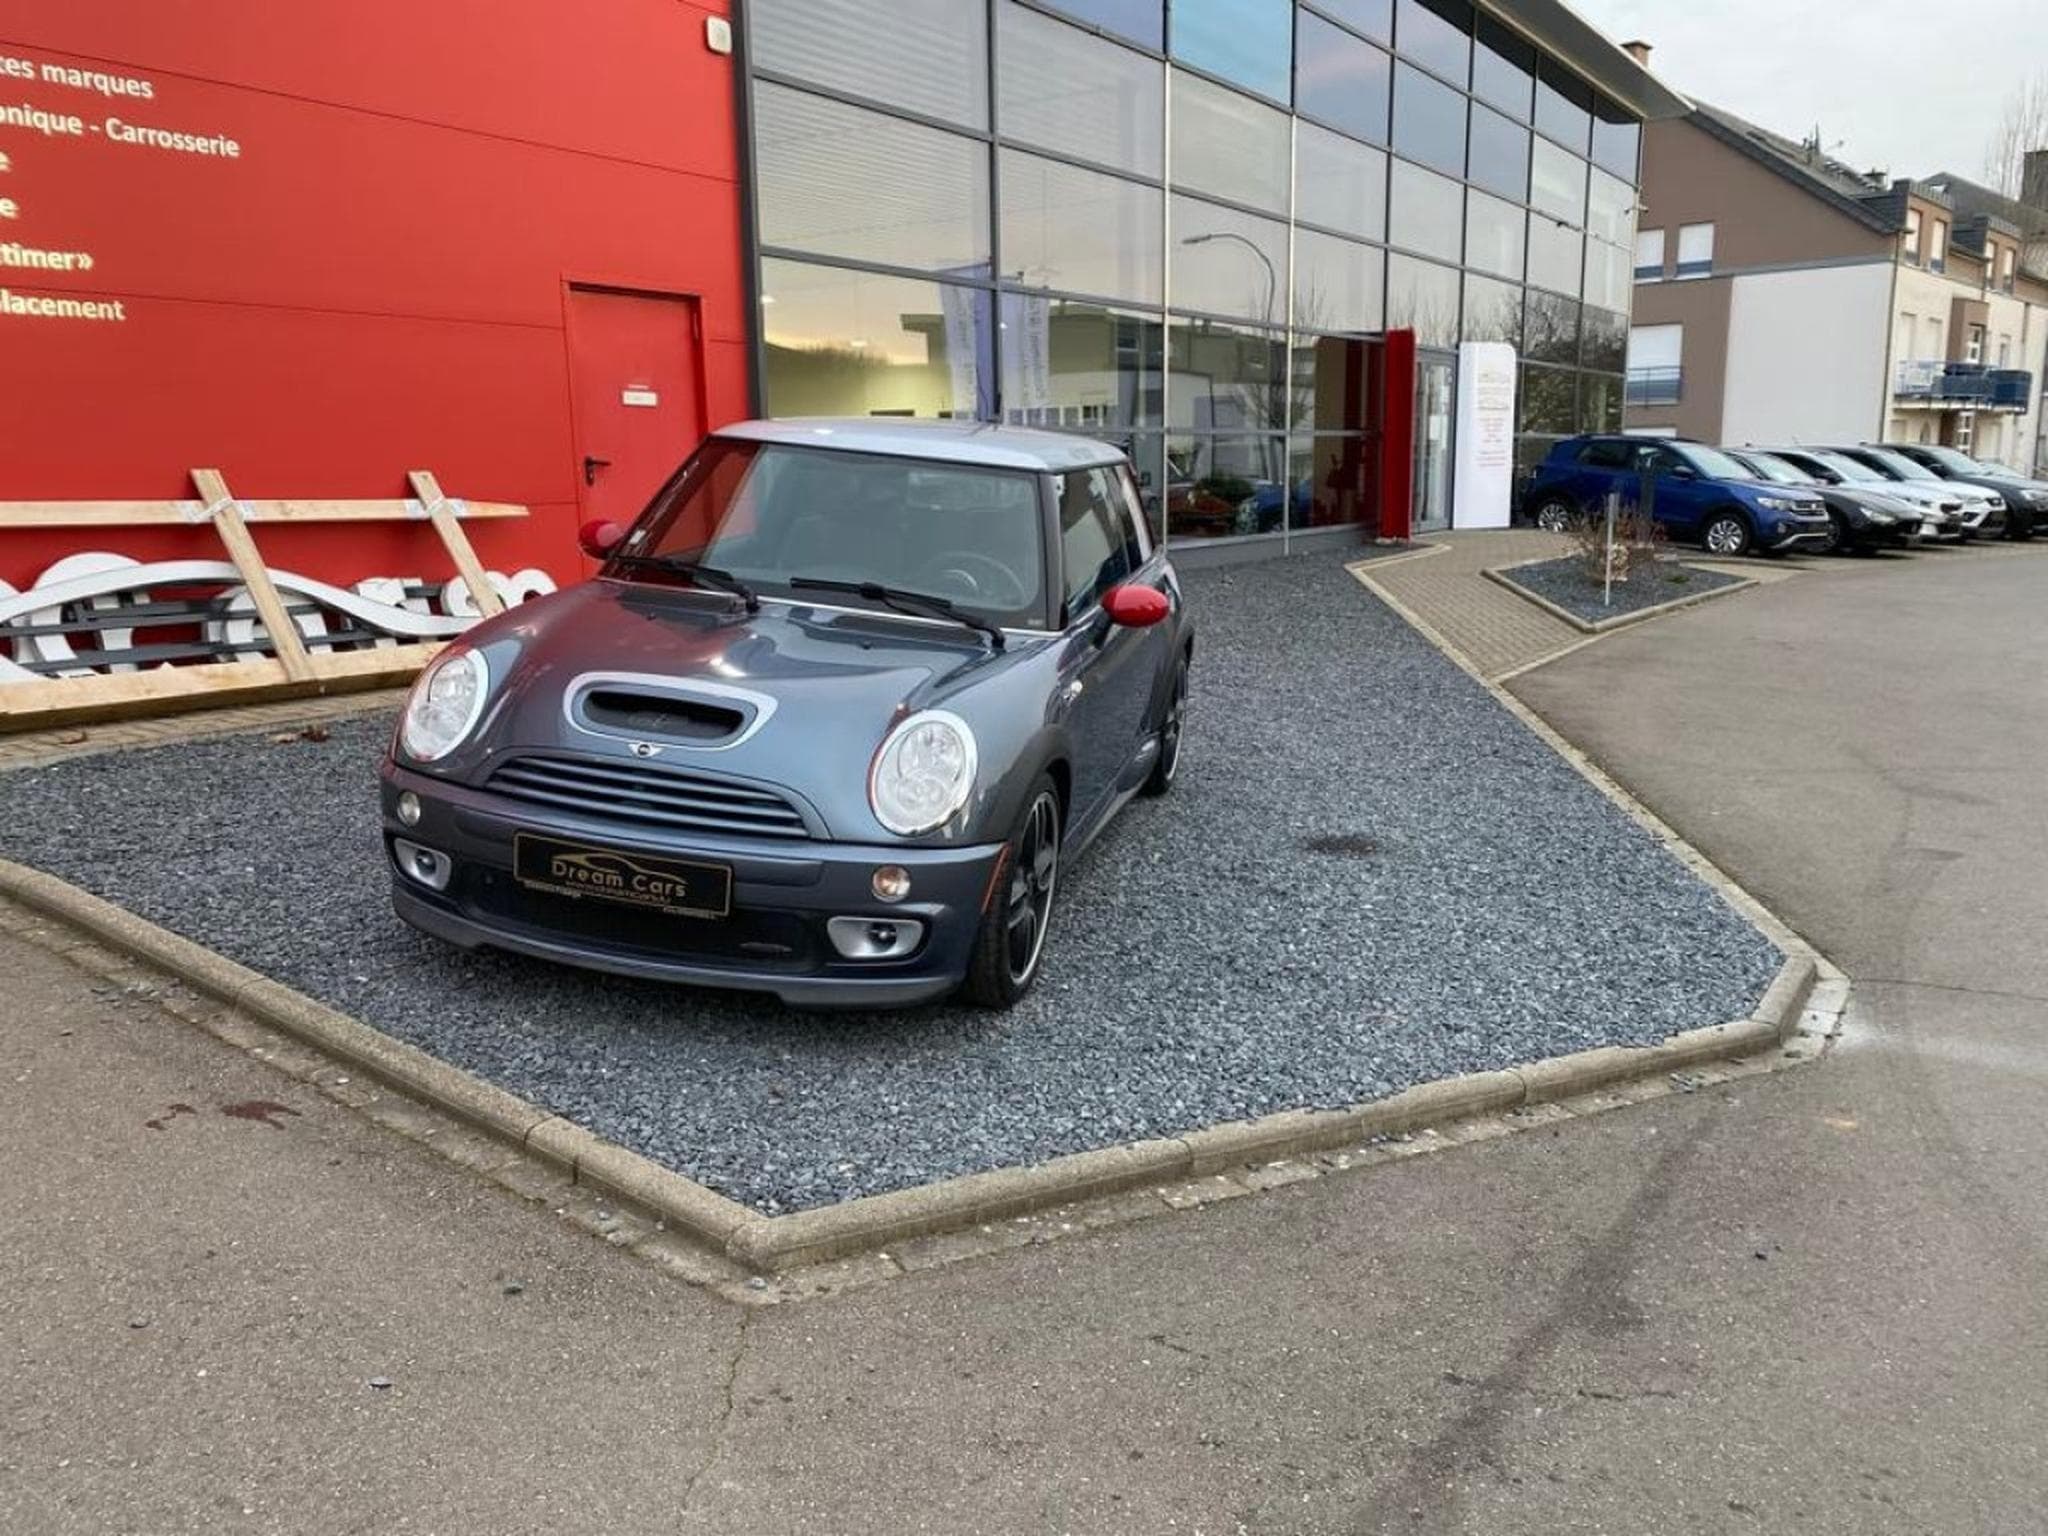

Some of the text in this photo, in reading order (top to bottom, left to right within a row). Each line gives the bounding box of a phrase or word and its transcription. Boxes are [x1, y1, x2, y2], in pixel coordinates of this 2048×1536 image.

[42, 63, 154, 99] marques
[105, 117, 241, 158] Carrosserie
[0, 243, 94, 271] timer»
[0, 288, 126, 321] lacement
[551, 860, 624, 887] Dream
[632, 874, 687, 897] Cars
